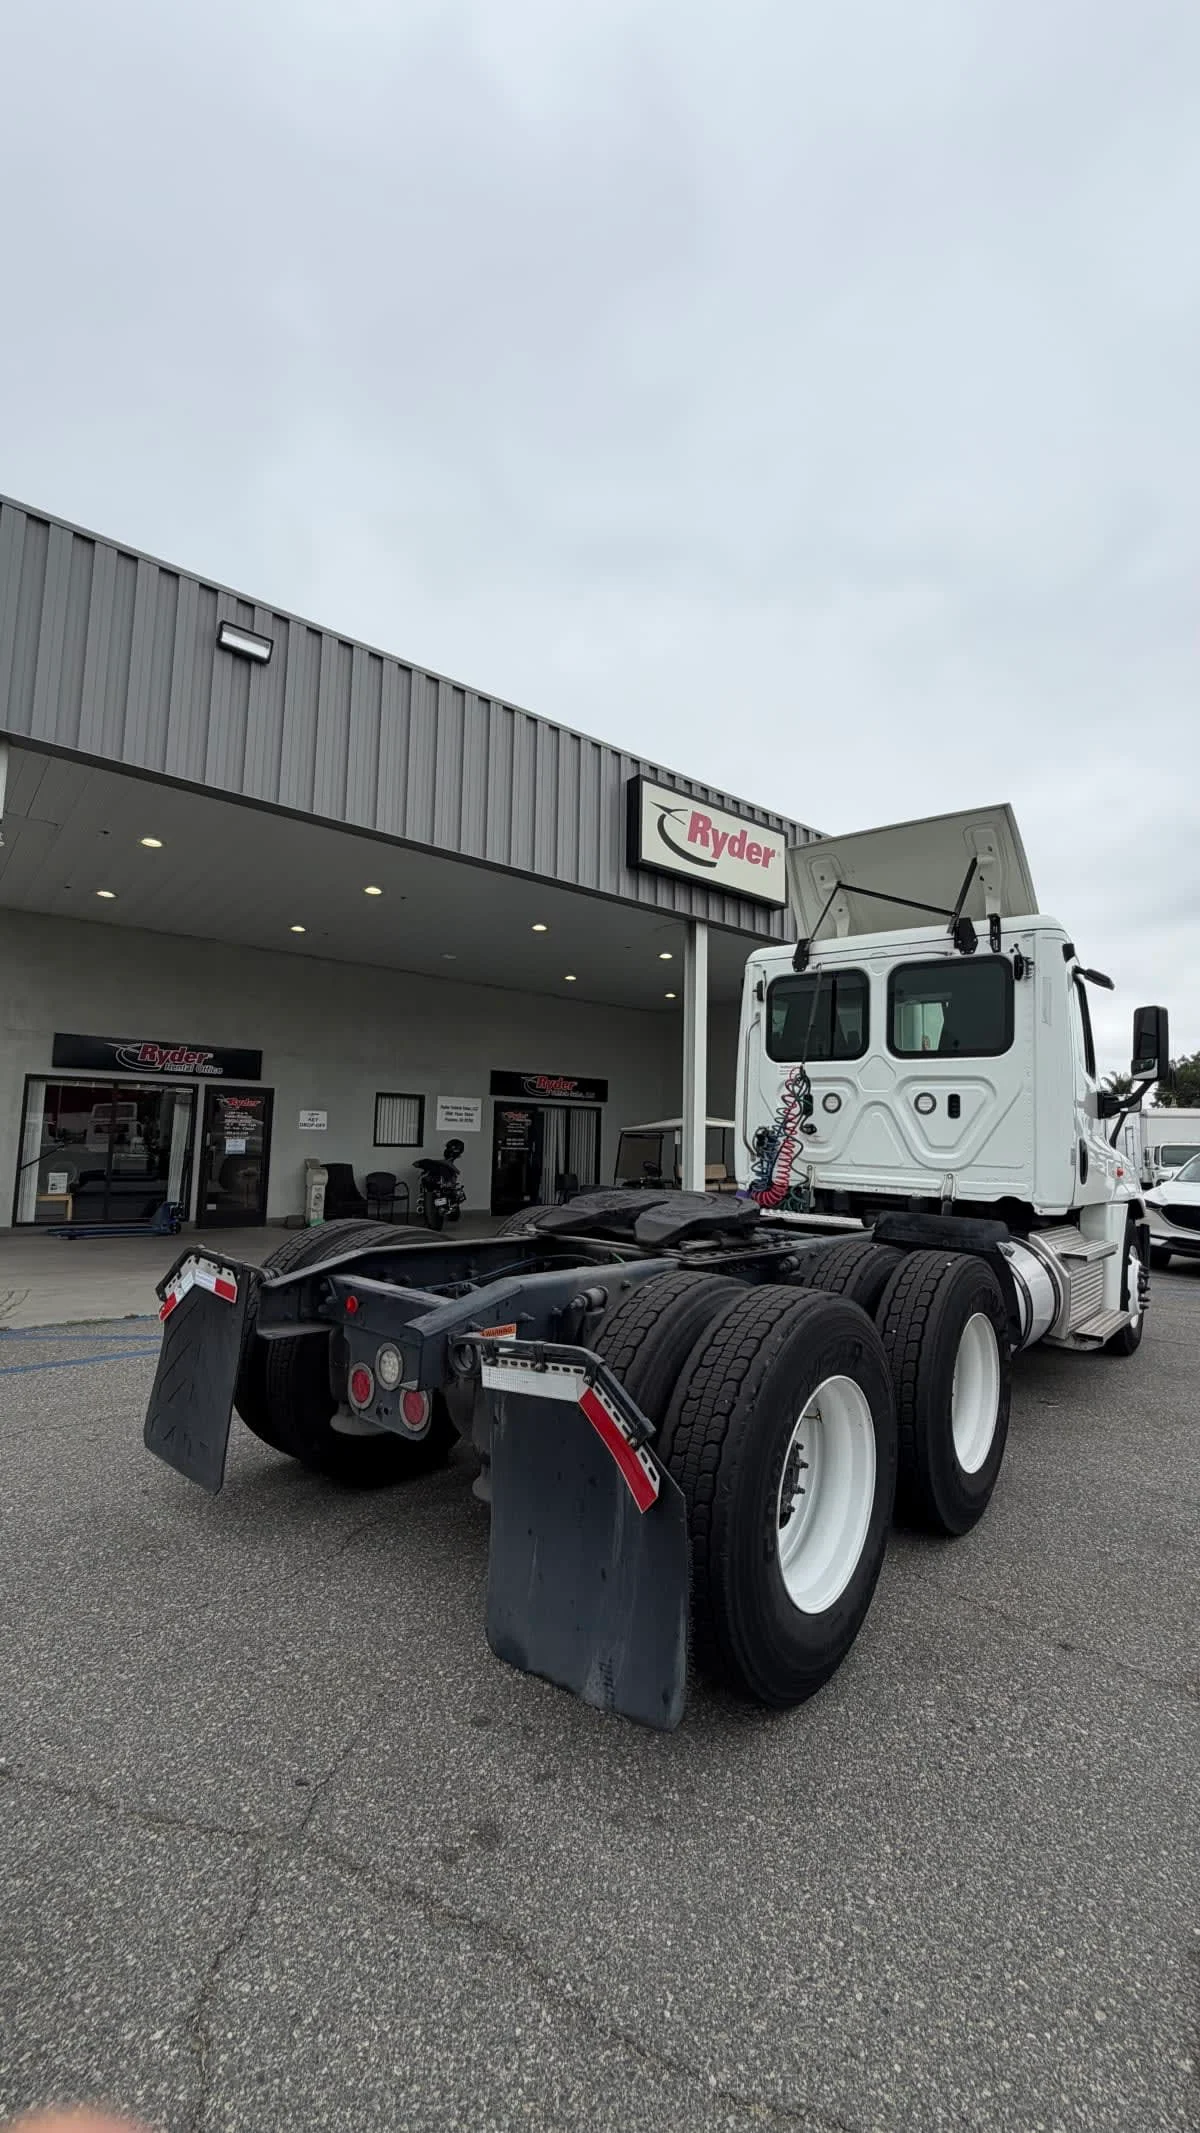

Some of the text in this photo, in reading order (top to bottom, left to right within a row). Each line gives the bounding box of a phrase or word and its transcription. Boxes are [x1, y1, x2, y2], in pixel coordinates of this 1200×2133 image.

[687, 810, 776, 869] Ryder
[137, 1042, 208, 1066] Ryder
[535, 1075, 575, 1091] Ryder
